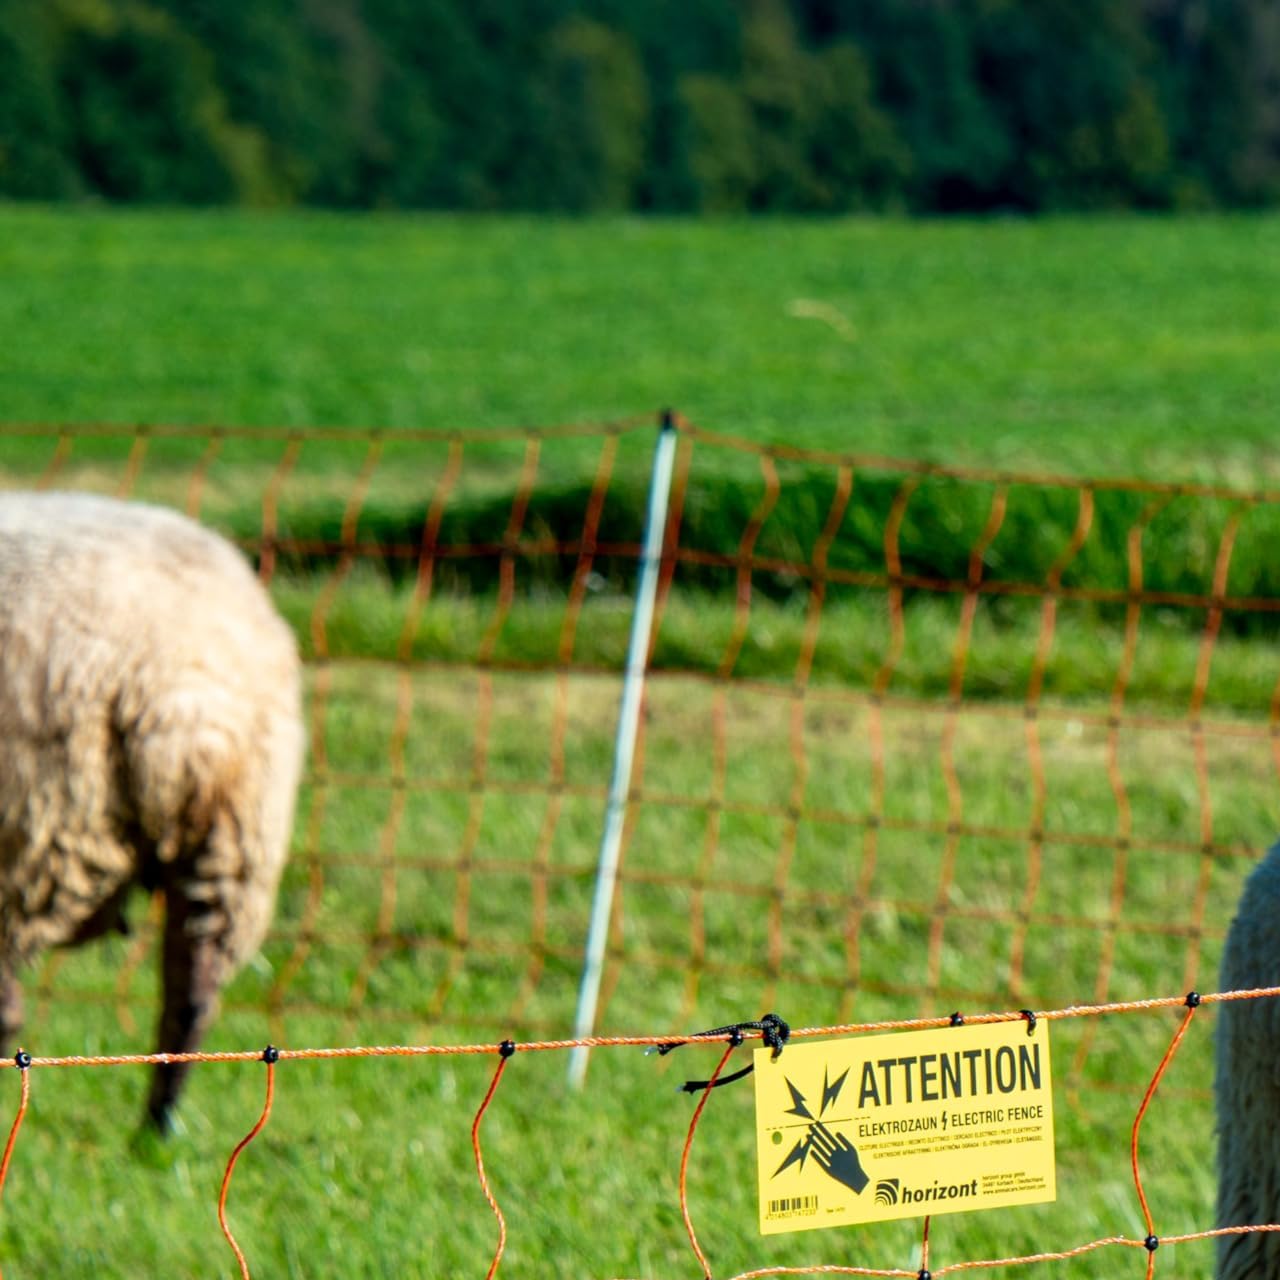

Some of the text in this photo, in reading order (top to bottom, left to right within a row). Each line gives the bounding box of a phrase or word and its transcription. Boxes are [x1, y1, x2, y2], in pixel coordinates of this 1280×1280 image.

[858, 1043, 1041, 1109] ATTENTION
[859, 1116, 937, 1137] ELEKTROZAUN
[951, 1105, 1043, 1127] ELECTRIC FENCE
[901, 1179, 977, 1204] horizont
